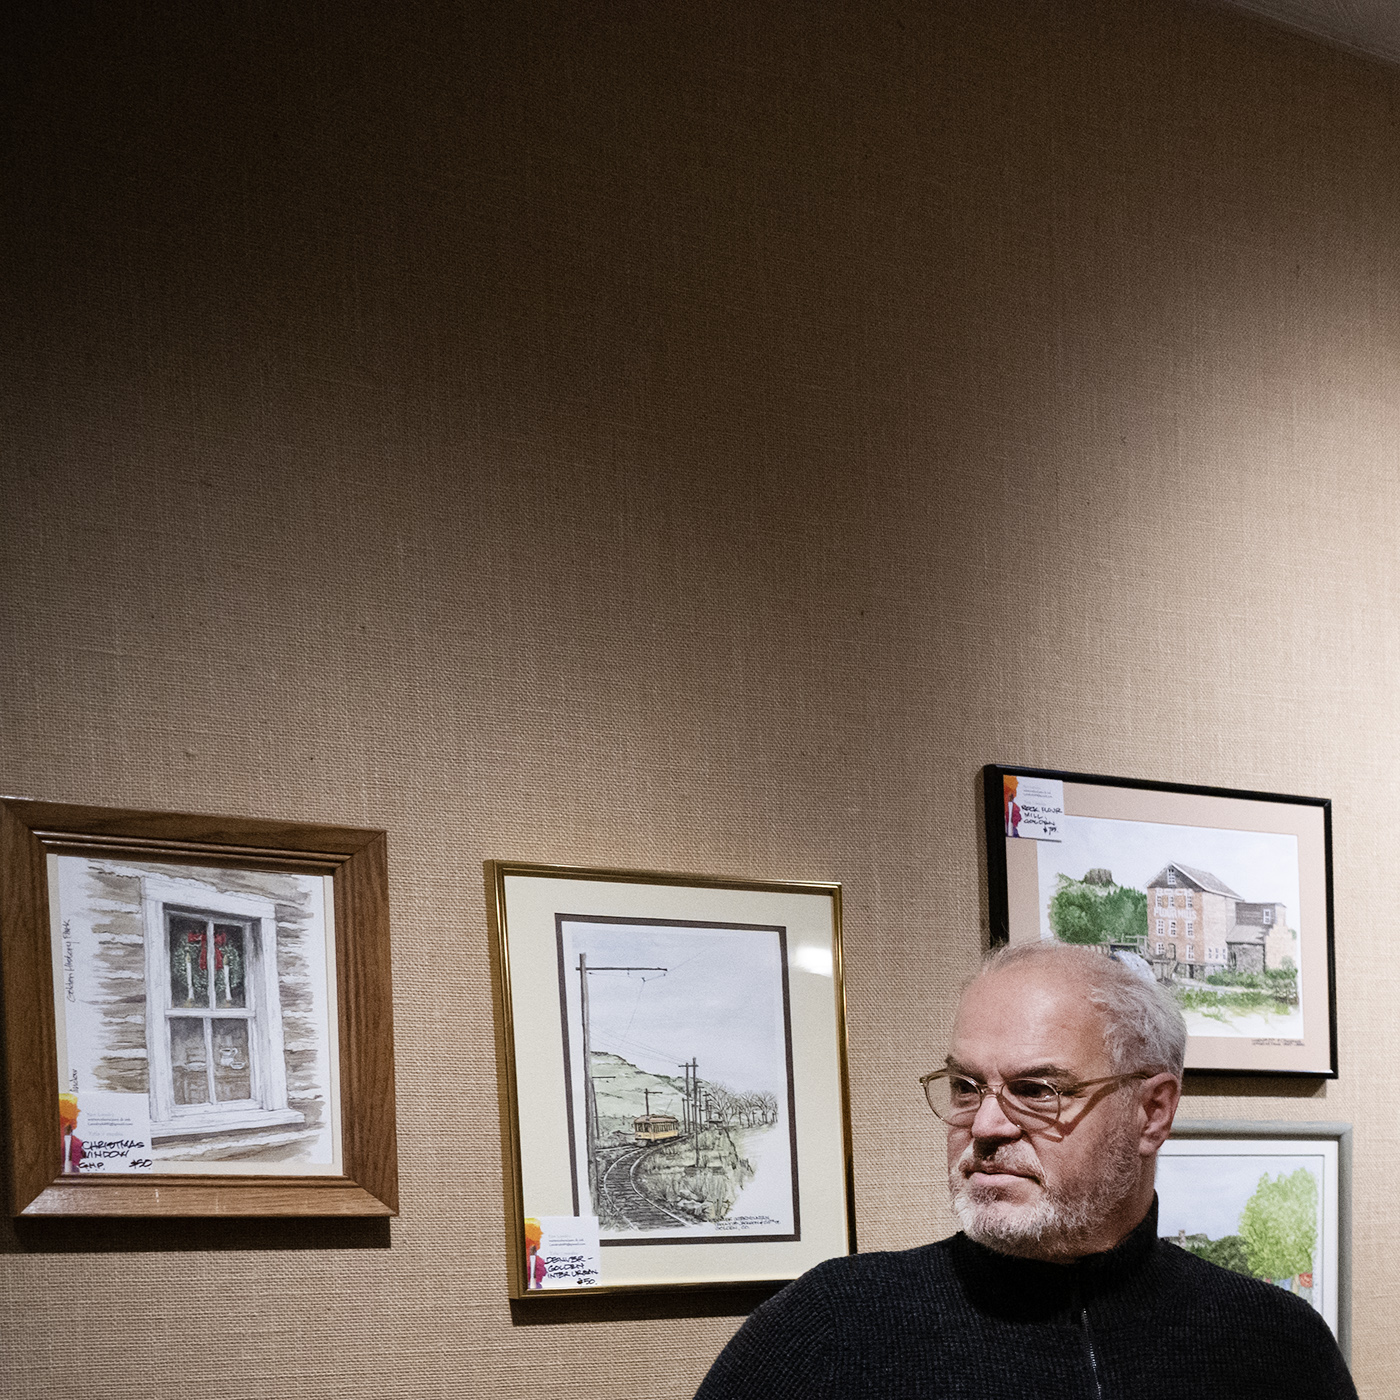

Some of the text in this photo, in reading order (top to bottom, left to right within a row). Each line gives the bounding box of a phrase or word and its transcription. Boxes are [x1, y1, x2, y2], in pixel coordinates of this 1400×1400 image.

[66, 971, 77, 1003] Golden
[81, 1139, 145, 1150] CHRISTMAS
[84, 1149, 130, 1159] WINDOW
[547, 1262, 585, 1273] GOLDEN
